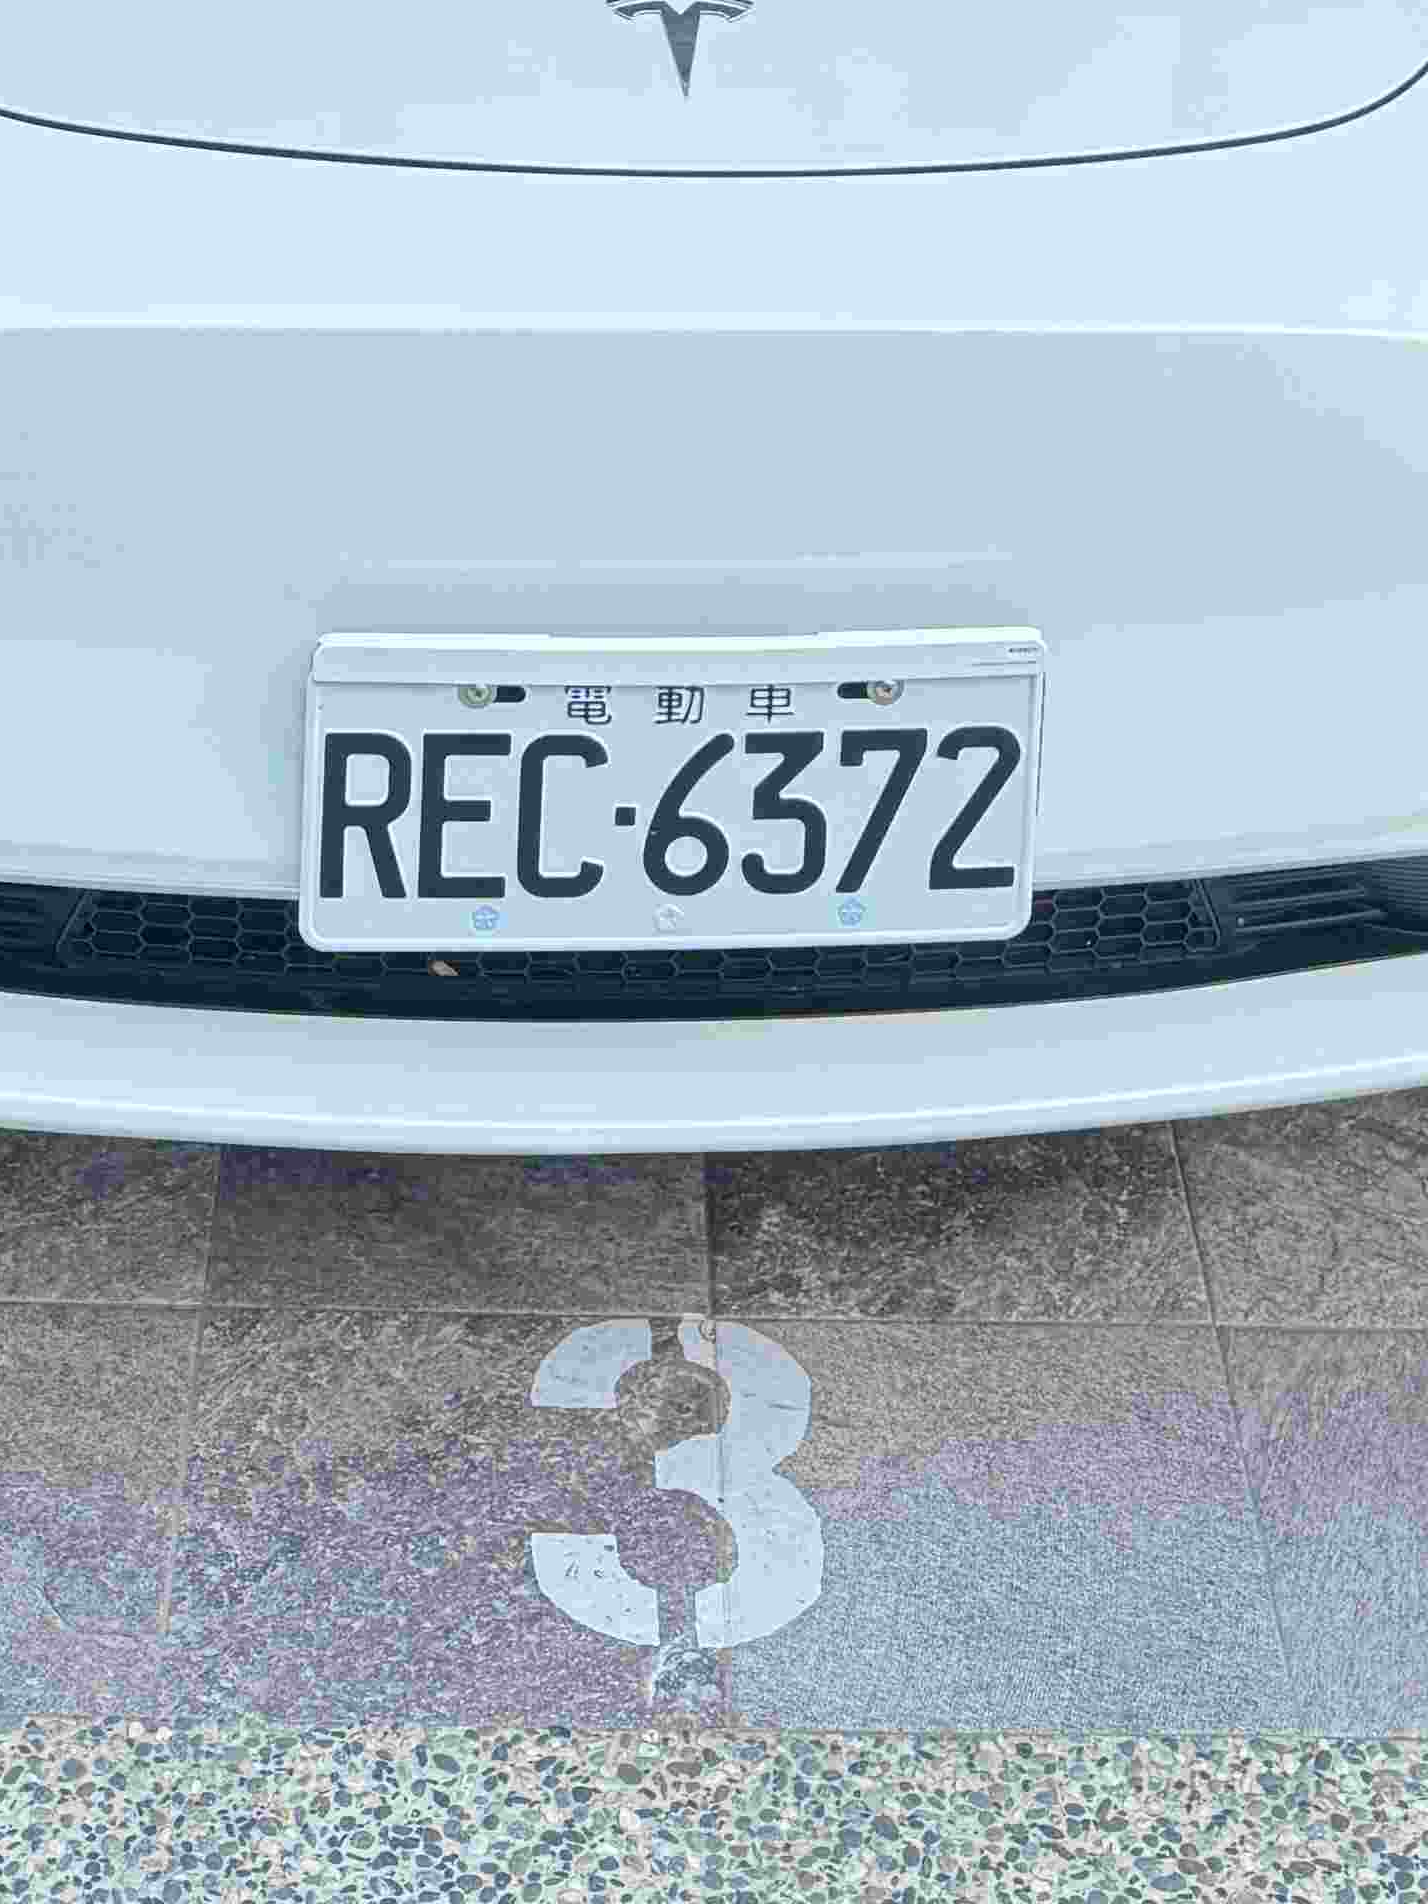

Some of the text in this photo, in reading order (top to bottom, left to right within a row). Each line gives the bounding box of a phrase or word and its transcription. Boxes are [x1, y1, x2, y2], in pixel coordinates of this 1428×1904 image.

[564, 684, 797, 725] 電動車
[531, 1313, 825, 1648] 3
